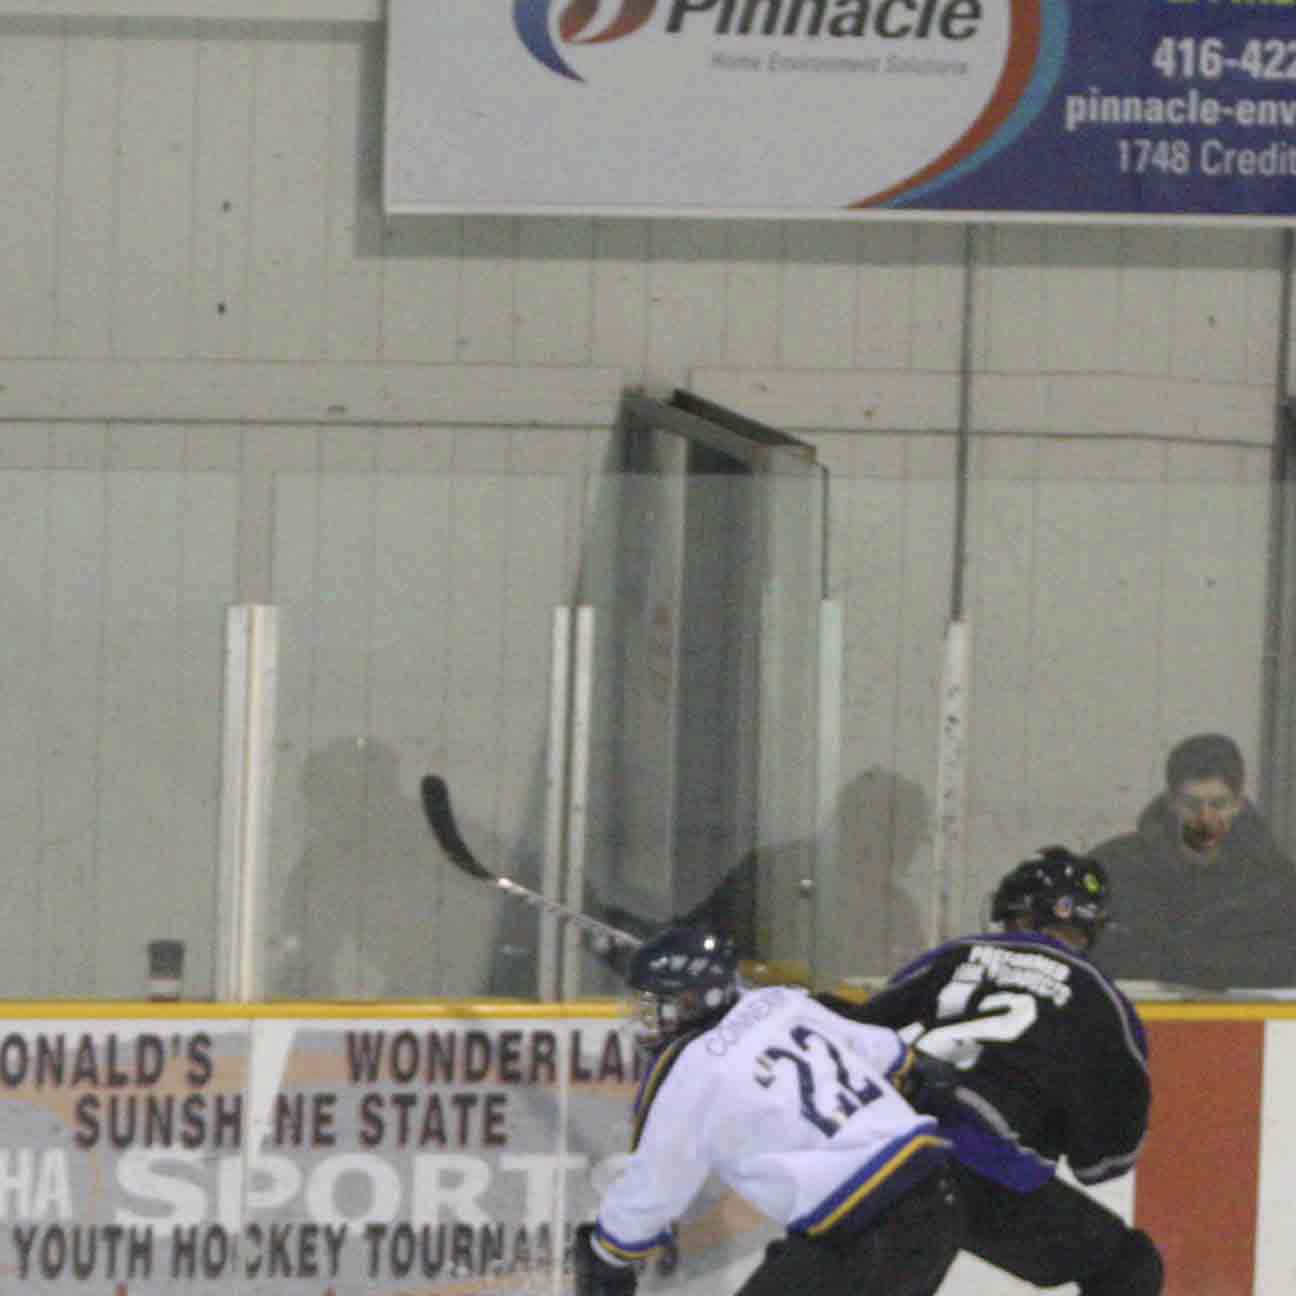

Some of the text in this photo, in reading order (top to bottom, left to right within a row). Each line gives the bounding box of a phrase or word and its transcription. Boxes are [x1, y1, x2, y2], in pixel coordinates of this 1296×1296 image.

[1117, 138, 1190, 174] 1748
[73, 1091, 508, 1151] SUNSHNE STATE
[11, 1223, 154, 1281] YOUTH
